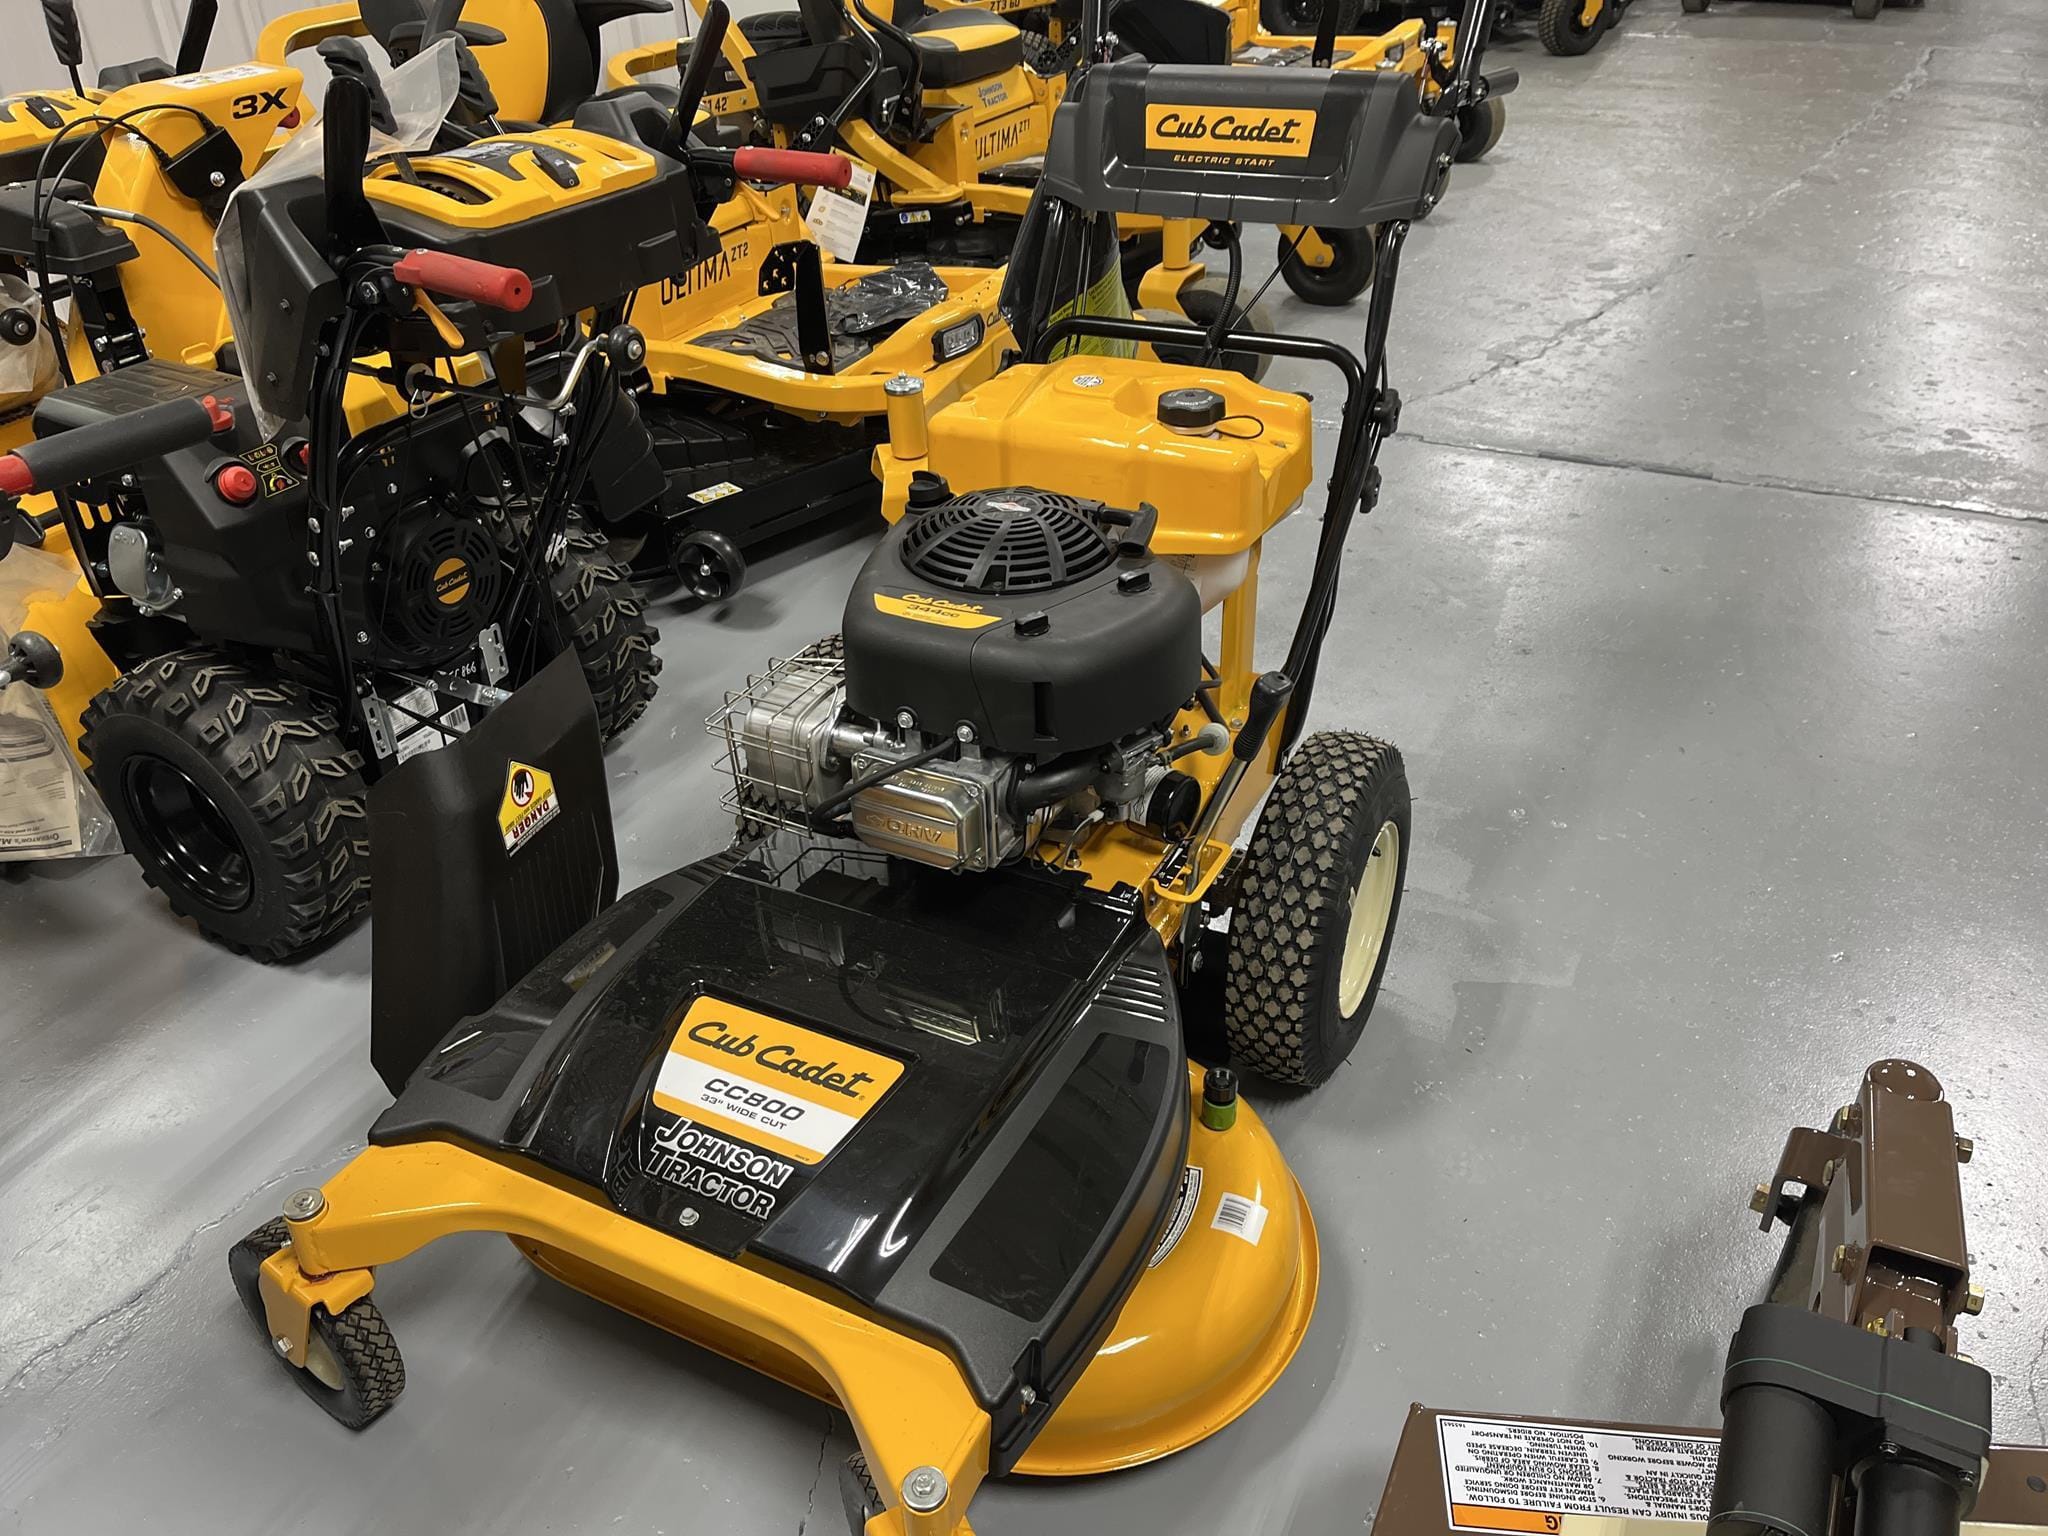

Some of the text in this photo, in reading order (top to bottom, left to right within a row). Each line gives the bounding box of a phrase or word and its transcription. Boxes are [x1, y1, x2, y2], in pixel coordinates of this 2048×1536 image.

[232, 87, 288, 119] 3X
[1156, 113, 1301, 144] Cub Cadet
[975, 119, 1030, 160] ULTIMA ZT1
[1173, 154, 1275, 167] ELECTRIC START
[731, 242, 748, 262] ZT2
[902, 594, 983, 613] Cub Cadet
[907, 604, 960, 617] 344cc
[513, 800, 549, 839] DANGER
[887, 818, 942, 843] OHV
[688, 1021, 874, 1098] Cub Cadet
[704, 1078, 805, 1121] CC800
[700, 1094, 787, 1130] 33" WIDE CUT
[654, 1116, 794, 1189] JOHNSON
[646, 1142, 775, 1220] TRACTOR
[1470, 1430, 1512, 1439] TRANSPORT
[1524, 1434, 1554, 1442] OPERATE
[1547, 1431, 1583, 1439] POSITION.
[1526, 1440, 1561, 1449] TURNING.
[1631, 1437, 1667, 1446] PERSONS.
[1488, 1443, 1522, 1452] DECREASE
[1524, 1446, 1555, 1454] TERRAIN.
[1676, 1447, 1708, 1455] OPERATE
[1481, 1449, 1521, 1458] OPERATING
[1557, 1449, 1587, 1457] UNEVEN
[1472, 1455, 1498, 1463] DEBRIS.
[1548, 1455, 1578, 1463] CAREFUL
[1607, 1454, 1645, 1462] WORKING
[1647, 1457, 1674, 1465] BEFORE
[1483, 1461, 1526, 1471] EQUIPMENT.
[1532, 1460, 1566, 1468] MOWING
[1676, 1459, 1704, 1467] MOWER
[1454, 1465, 1501, 1475] UNQUALIFIED
[1516, 1470, 1550, 1479] CHILDREN
[1557, 1468, 1591, 1476] PERSONS
[1500, 1475, 1526, 1483] WORK.
[1567, 1474, 1592, 1482] ALLOW
[1633, 1474, 1666, 1483] TRACTOR
[1670, 1471, 1702, 1479] QUICKLY
[1464, 1478, 1492, 1487] SERVICE
[1493, 1481, 1518, 1489] DOING
[1528, 1478, 1580, 1488] MAINTENANCE
[1668, 1477, 1687, 1485] STOP
[1463, 1485, 1517, 1495] DISMOUNTING.
[1520, 1483, 1547, 1491] BEFORE
[1565, 1487, 1595, 1495] REMOVE
[1624, 1486, 1648, 1494] PLACE.
[1520, 1490, 1546, 1498] BEFORE
[1548, 1492, 1575, 1500] ENGINE
[1623, 1492, 1677, 1502] PRECAUTIONS.
[1661, 1489, 1692, 1498] GUARDS
[1465, 1493, 1505, 1504] FOLLOW.
[1508, 1497, 1519, 1505] TO
[1522, 1498, 1561, 1508] FAILURE
[1679, 1497, 1705, 1505] SAFETY
[1563, 1502, 1591, 1511] FROM
[1593, 1504, 1629, 1514] RESULT
[1652, 1501, 1686, 1510] MANUAL
[1631, 1507, 1651, 1516] CAN
[1654, 1509, 1687, 1519] INJURY
